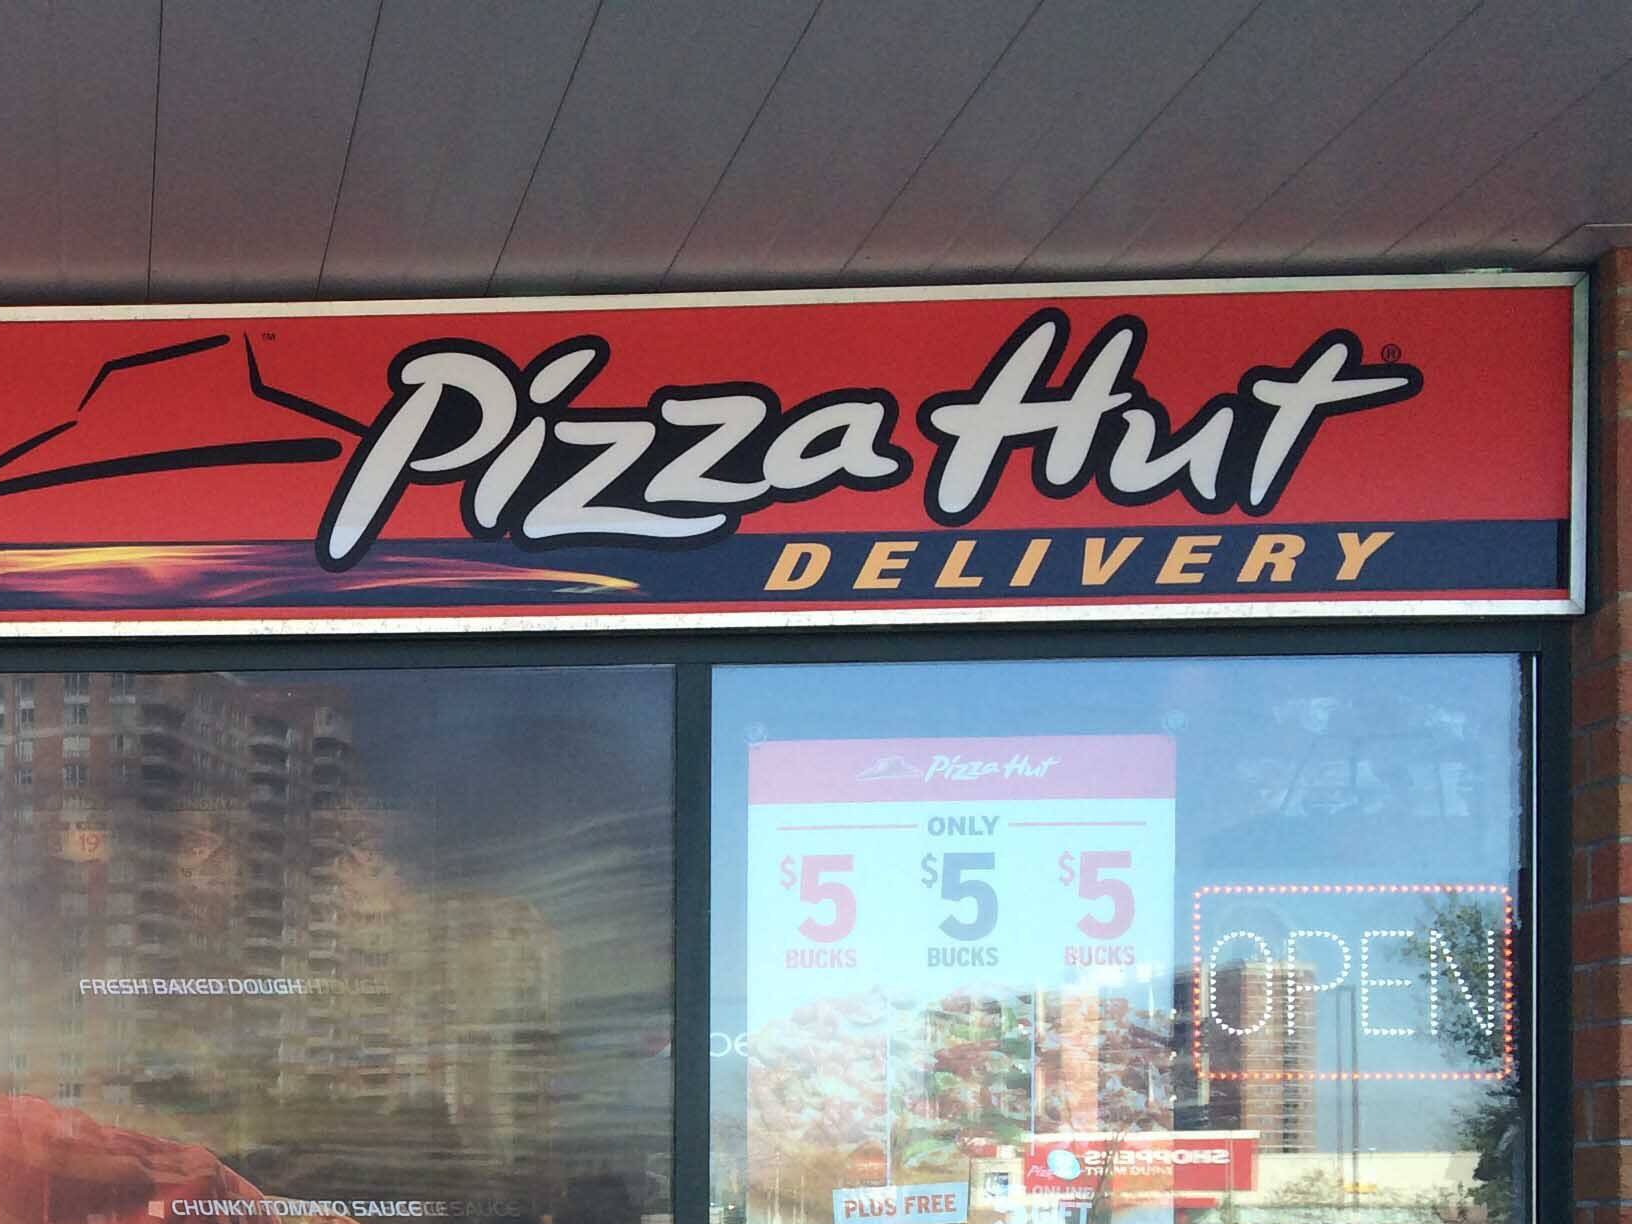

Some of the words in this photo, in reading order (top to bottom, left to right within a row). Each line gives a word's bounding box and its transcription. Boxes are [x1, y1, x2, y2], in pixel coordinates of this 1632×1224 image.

[318, 337, 913, 572] Pizza
[917, 308, 1423, 526] Hut
[764, 531, 1396, 591] DELIVERY
[924, 754, 1001, 783] Pizza
[1003, 753, 1064, 778] Hut
[927, 815, 1001, 836] ONLY
[779, 853, 858, 944] $5
[920, 851, 999, 942] $5
[1057, 850, 1136, 940] $5
[785, 948, 858, 969] BUCKS
[927, 946, 1000, 968] BUCKS
[1063, 944, 1137, 967] BUCKS
[79, 978, 148, 995] FRESH
[152, 978, 224, 995] BAKED
[229, 978, 302, 995] DOUGH
[1209, 929, 1496, 1036] OPEN
[171, 1200, 255, 1217] CHUNKY
[262, 1200, 347, 1217] TOMATO
[352, 1200, 422, 1217] SAUCE
[844, 1198, 897, 1219] PLUS
[903, 1193, 957, 1215] FREE
